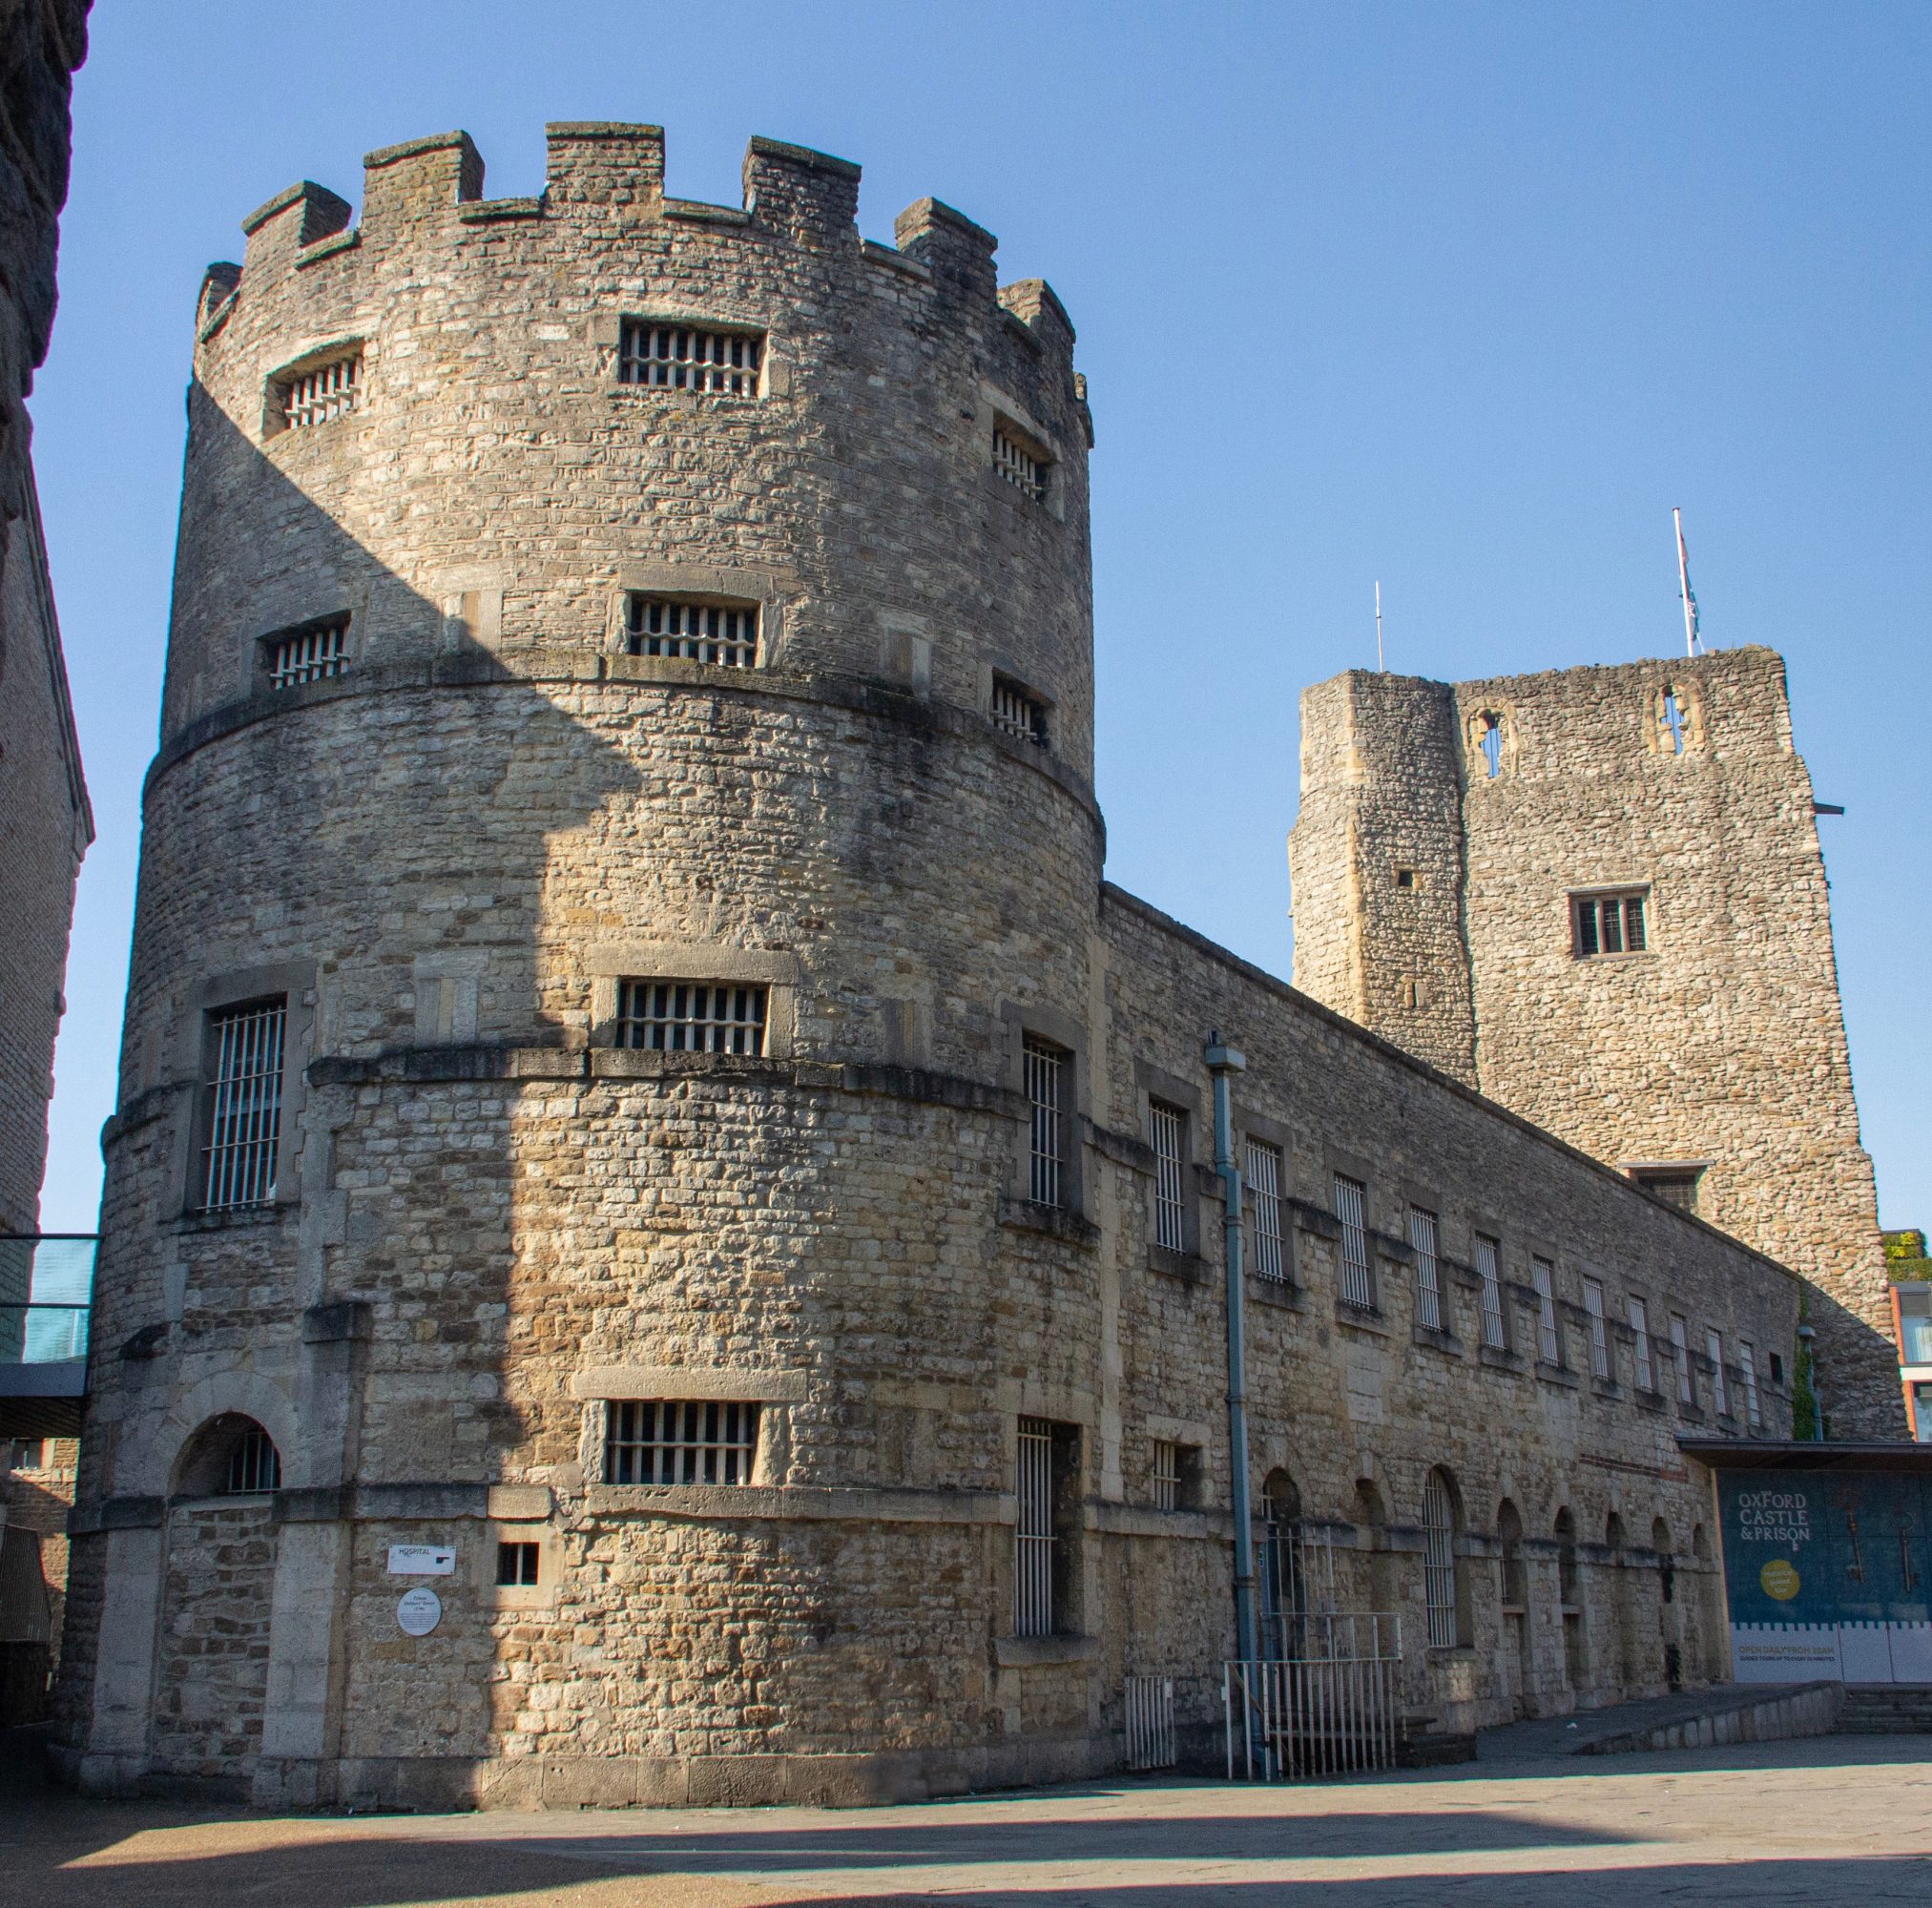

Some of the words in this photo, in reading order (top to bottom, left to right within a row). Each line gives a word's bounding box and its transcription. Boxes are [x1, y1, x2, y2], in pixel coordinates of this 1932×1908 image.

[1738, 1492, 1806, 1509] OXFORD
[1739, 1509, 1808, 1525] CASTLE
[1738, 1646, 1761, 1654] OPEN
[1787, 1647, 1810, 1655] FROM
